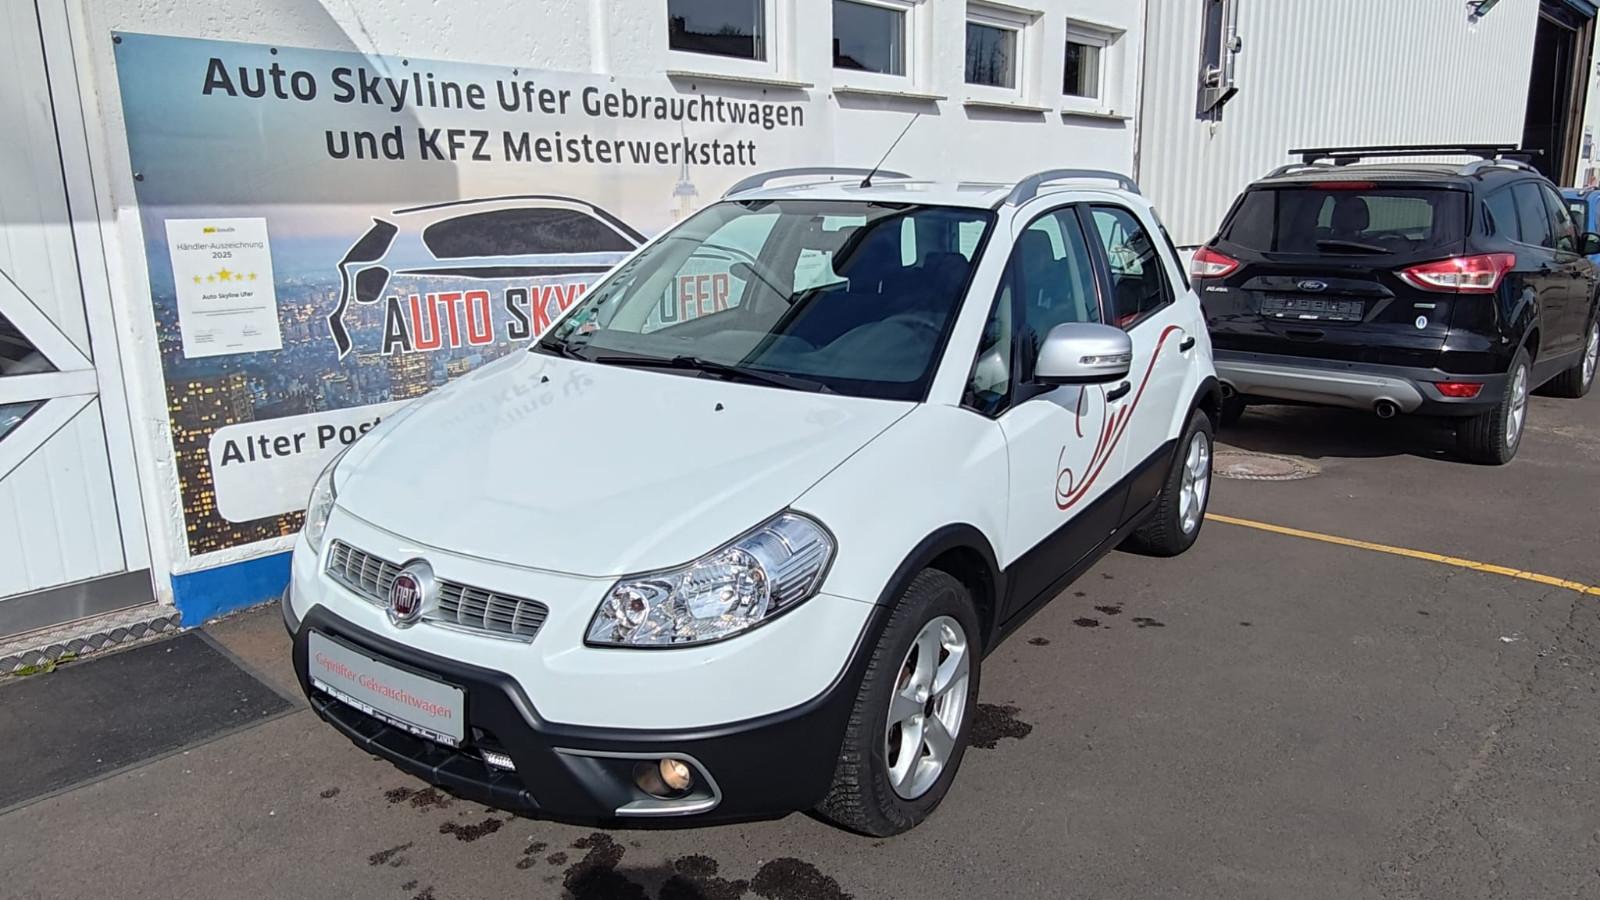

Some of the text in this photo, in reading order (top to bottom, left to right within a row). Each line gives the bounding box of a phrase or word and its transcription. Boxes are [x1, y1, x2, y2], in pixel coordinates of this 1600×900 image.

[202, 57, 804, 130] Auto Skyline Ufer Gebrauchtwagen
[325, 125, 757, 166] und KFZ Meisterwerkstatt
[177, 241, 264, 251] Händler-Auszeichnung
[212, 251, 232, 259] 2025
[218, 292, 239, 300] Skyline
[382, 273, 729, 354] AUTO SKY UFER
[220, 431, 306, 467] Alter
[396, 585, 415, 608] FIAT
[315, 653, 357, 681] Geprüfter
[360, 674, 453, 719] Gebrauchtwagen
